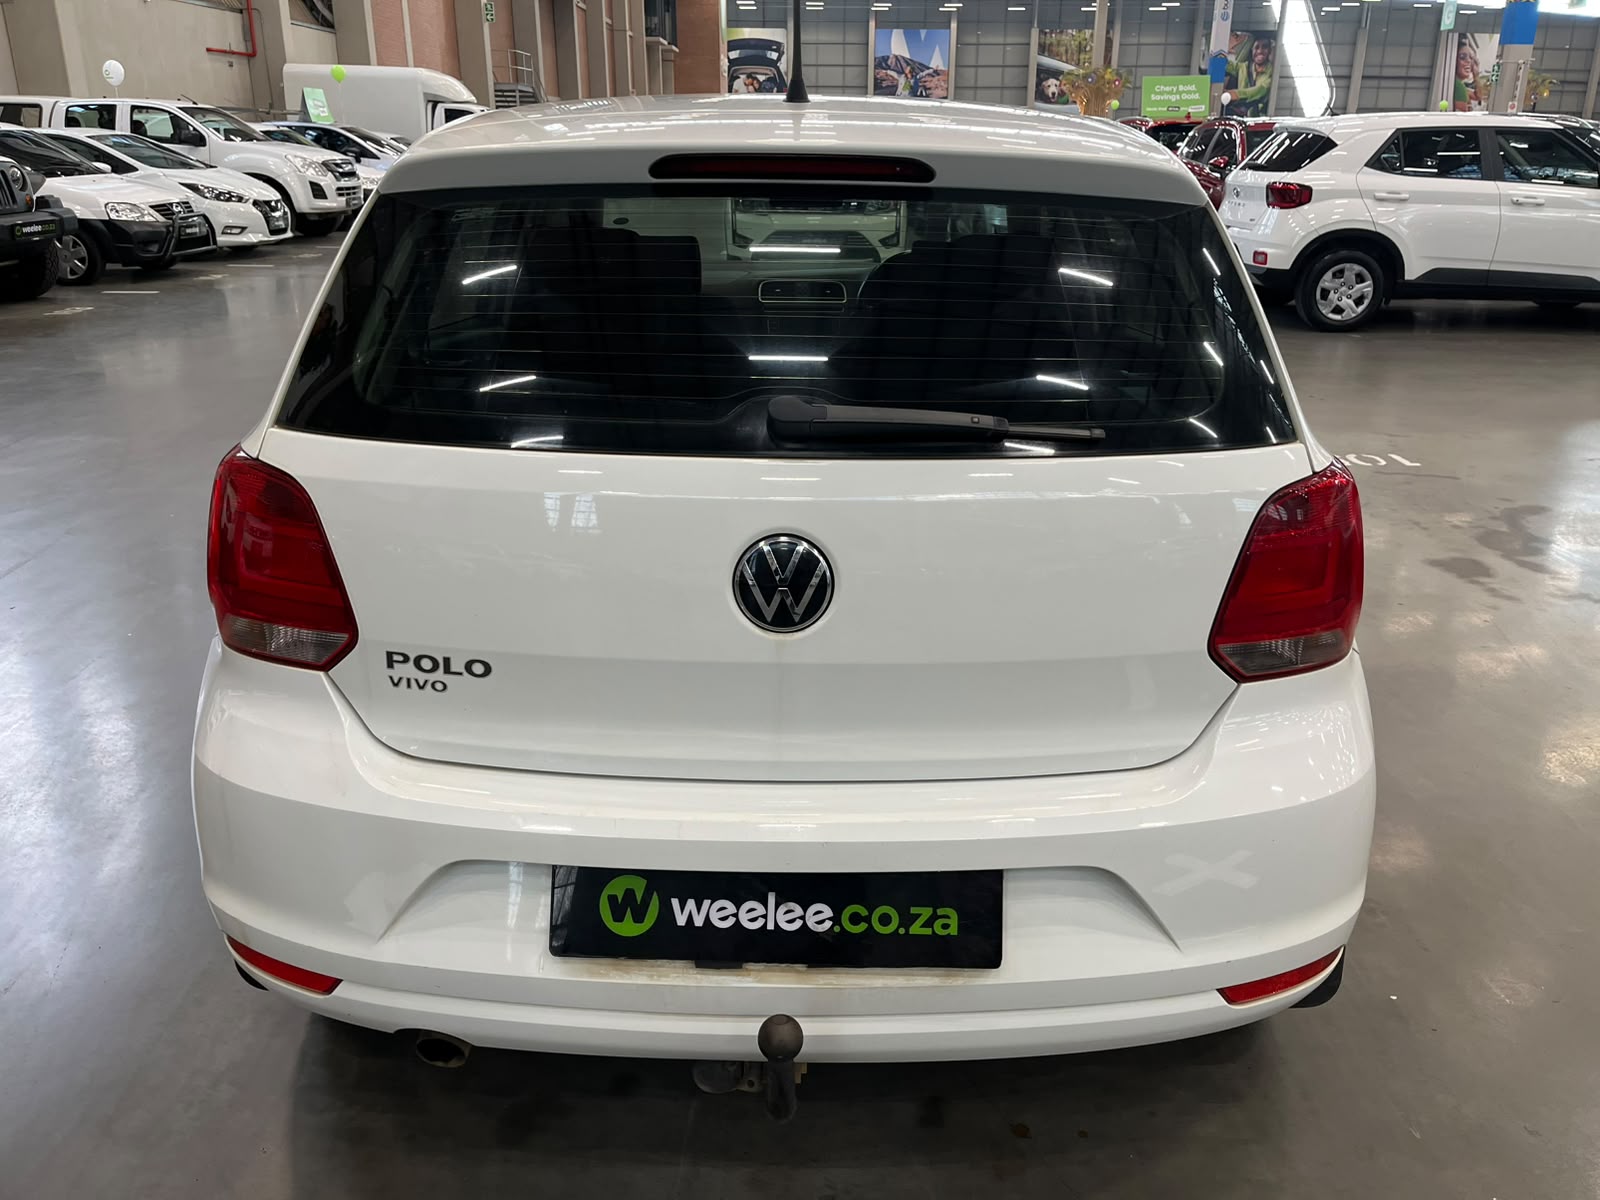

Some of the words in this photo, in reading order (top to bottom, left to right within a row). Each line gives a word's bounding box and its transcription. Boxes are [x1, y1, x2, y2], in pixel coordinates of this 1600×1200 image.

[1151, 93, 1180, 101] Savings
[385, 650, 493, 679] POLO
[388, 675, 448, 693] VIVO
[670, 891, 959, 936] weelee.co.za
